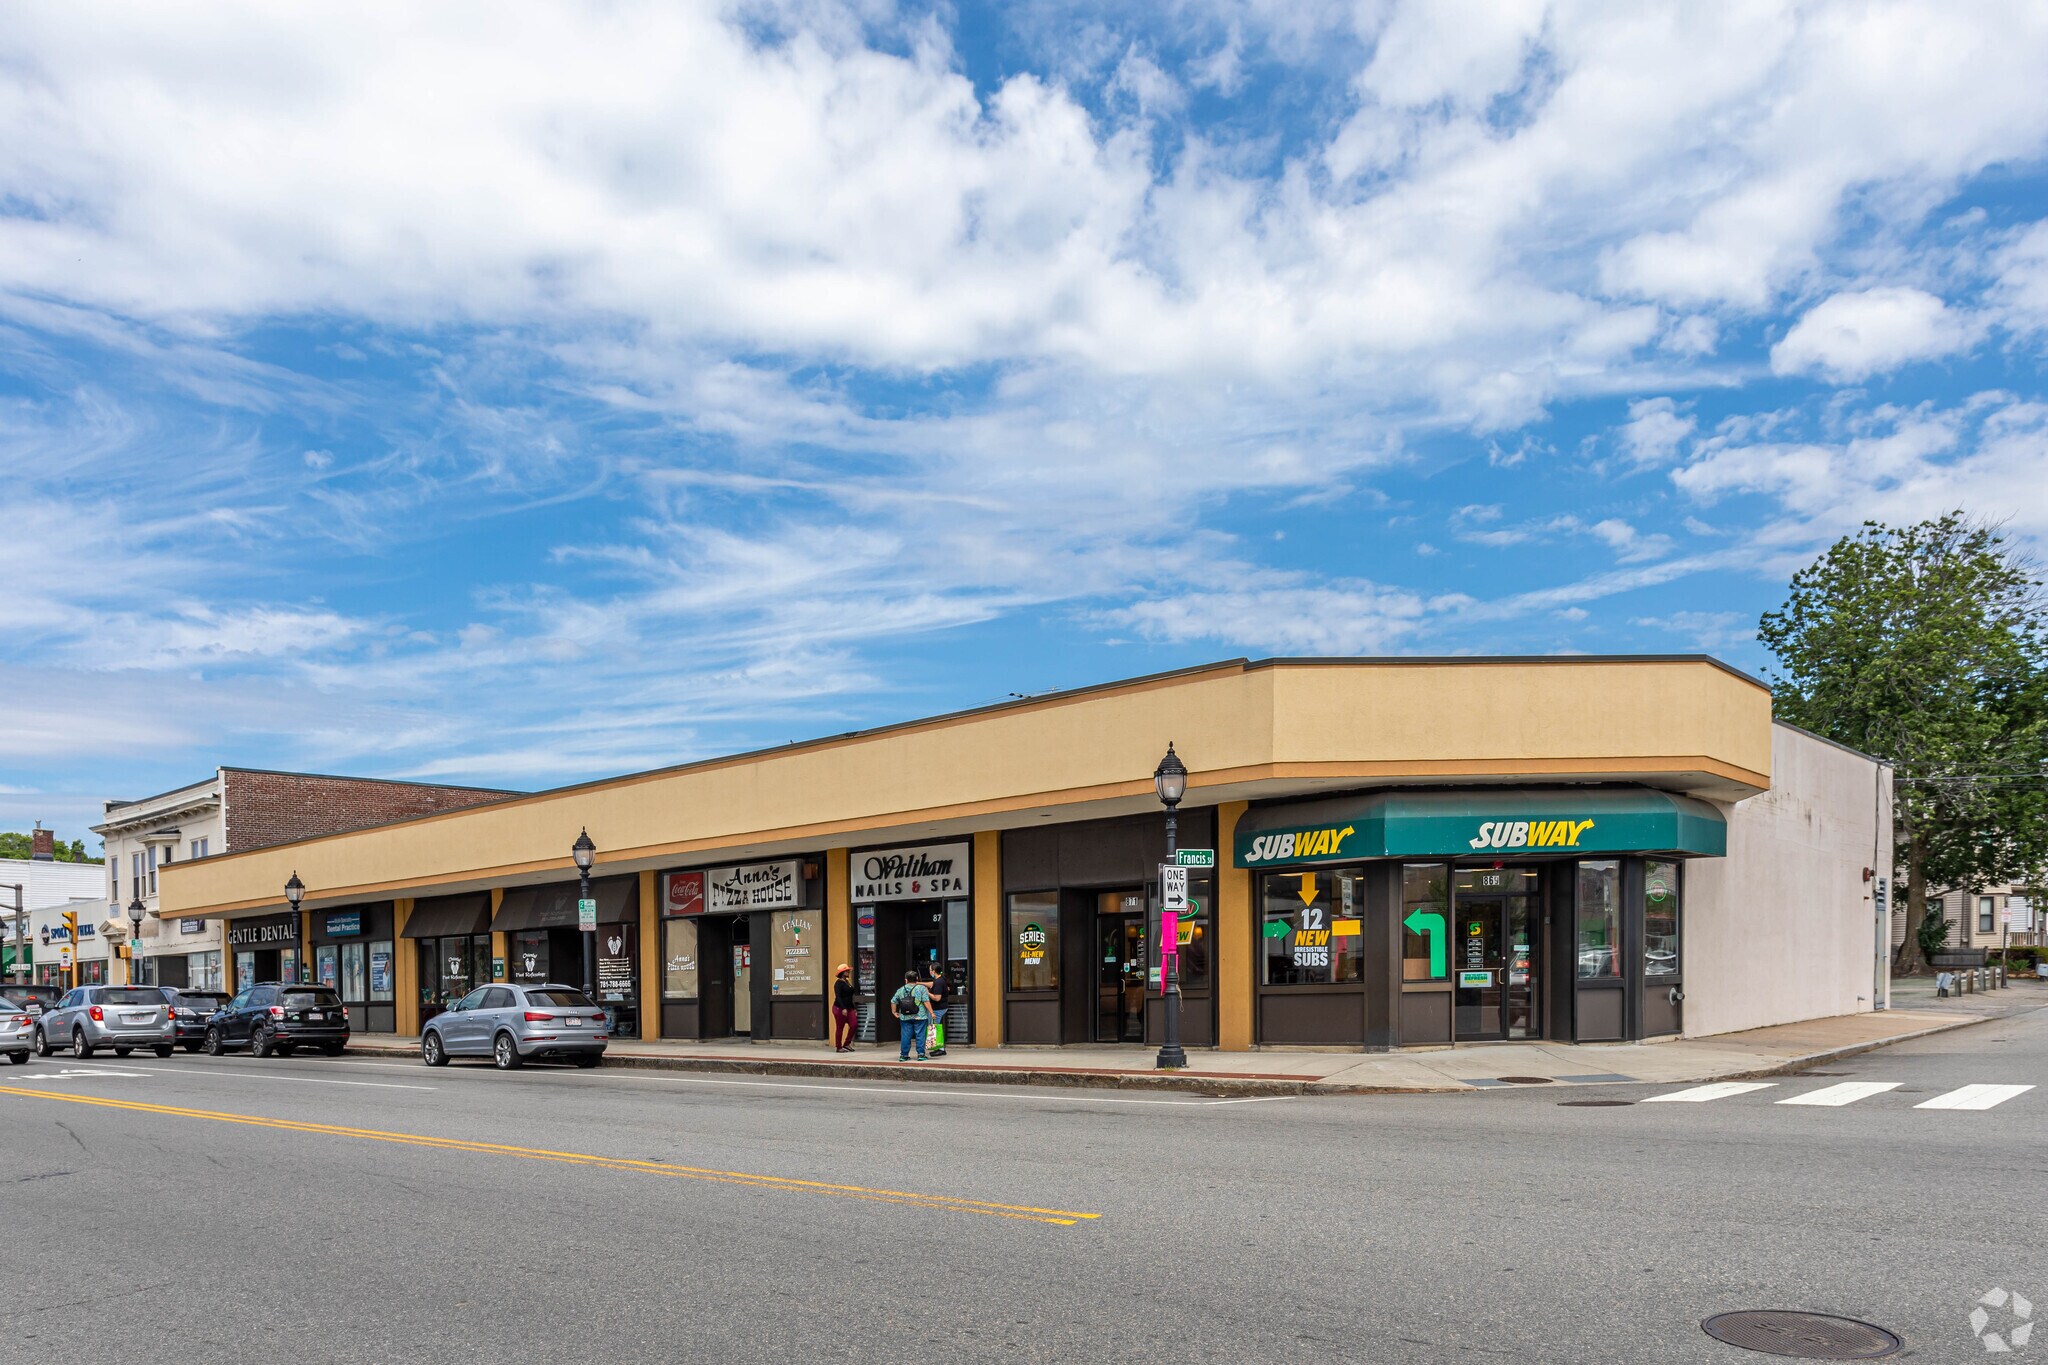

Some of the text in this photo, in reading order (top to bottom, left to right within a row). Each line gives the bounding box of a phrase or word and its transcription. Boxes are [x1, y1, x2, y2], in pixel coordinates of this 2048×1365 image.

[1469, 819, 1595, 849] SUBWAY
[1244, 825, 1355, 863] SUBWAY
[1179, 851, 1206, 864] Francis
[864, 853, 953, 880] Waltham
[724, 865, 780, 887] Anna's
[1166, 869, 1185, 880] ONE
[1483, 876, 1499, 886] 869
[752, 874, 792, 904] HOUSE
[855, 878, 962, 897] NAILS & SPA
[1166, 881, 1185, 892] WAY
[782, 918, 812, 933] ITALIAN
[1301, 908, 1323, 930] 12
[227, 923, 294, 944] GENTLE DENTAL
[326, 922, 360, 933] Dental Practice
[1019, 931, 1045, 944] SERIES
[1294, 930, 1330, 946] NEW
[1020, 950, 1044, 958] ALL-NEW
[1293, 953, 1328, 967] SUBS
